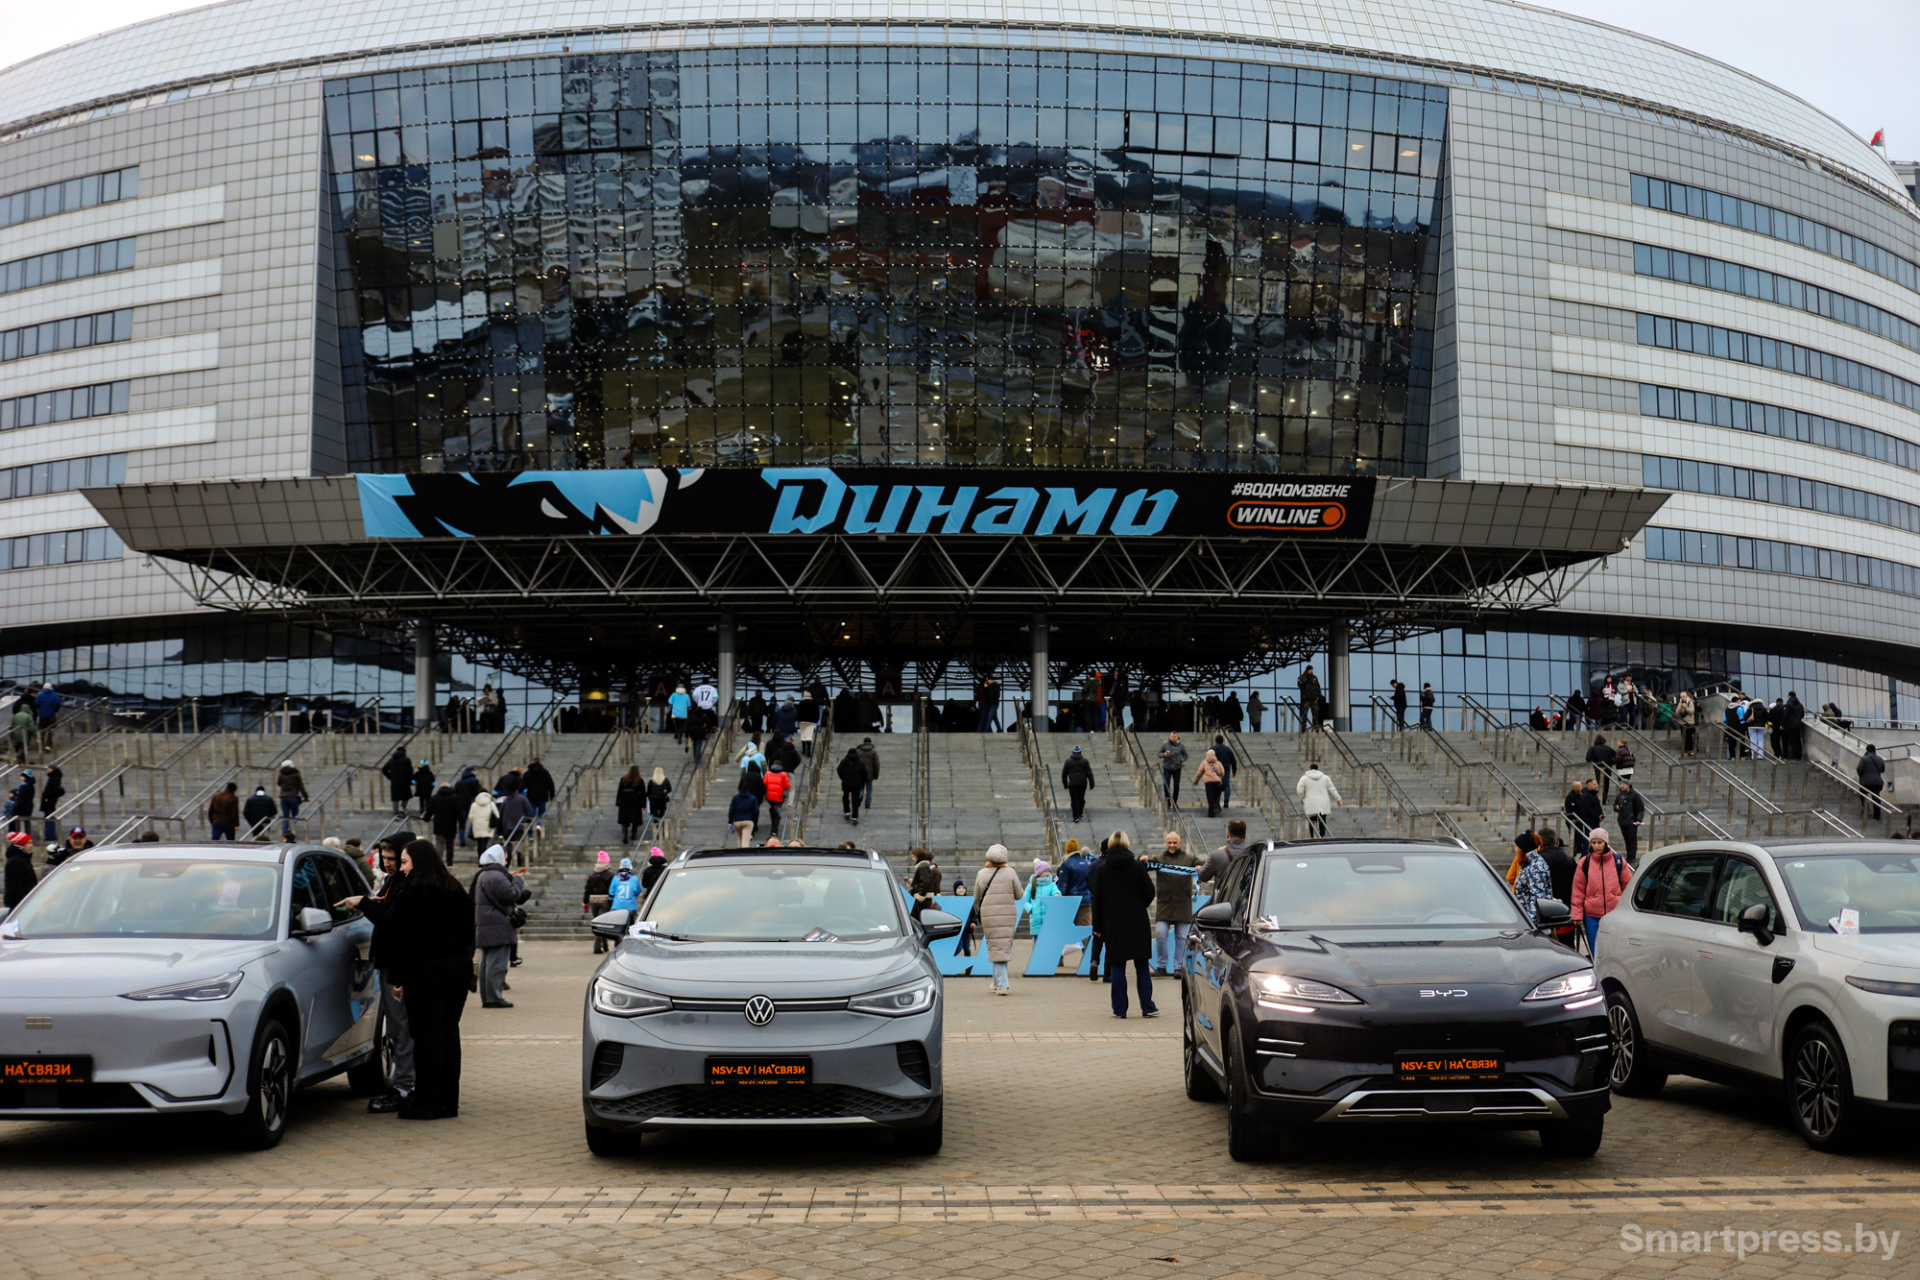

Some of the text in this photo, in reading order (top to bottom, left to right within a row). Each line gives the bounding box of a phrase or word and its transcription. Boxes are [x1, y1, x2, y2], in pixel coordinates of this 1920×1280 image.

[1231, 482, 1351, 498] #ВОДНОМЗВЕНЕ
[1237, 507, 1321, 524] WINLINE
[701, 690, 711, 701] 17
[617, 885, 630, 899] 21
[1419, 989, 1468, 997] BYD
[712, 1066, 751, 1075] NSV-EV
[1401, 1061, 1442, 1071] NSV-EV
